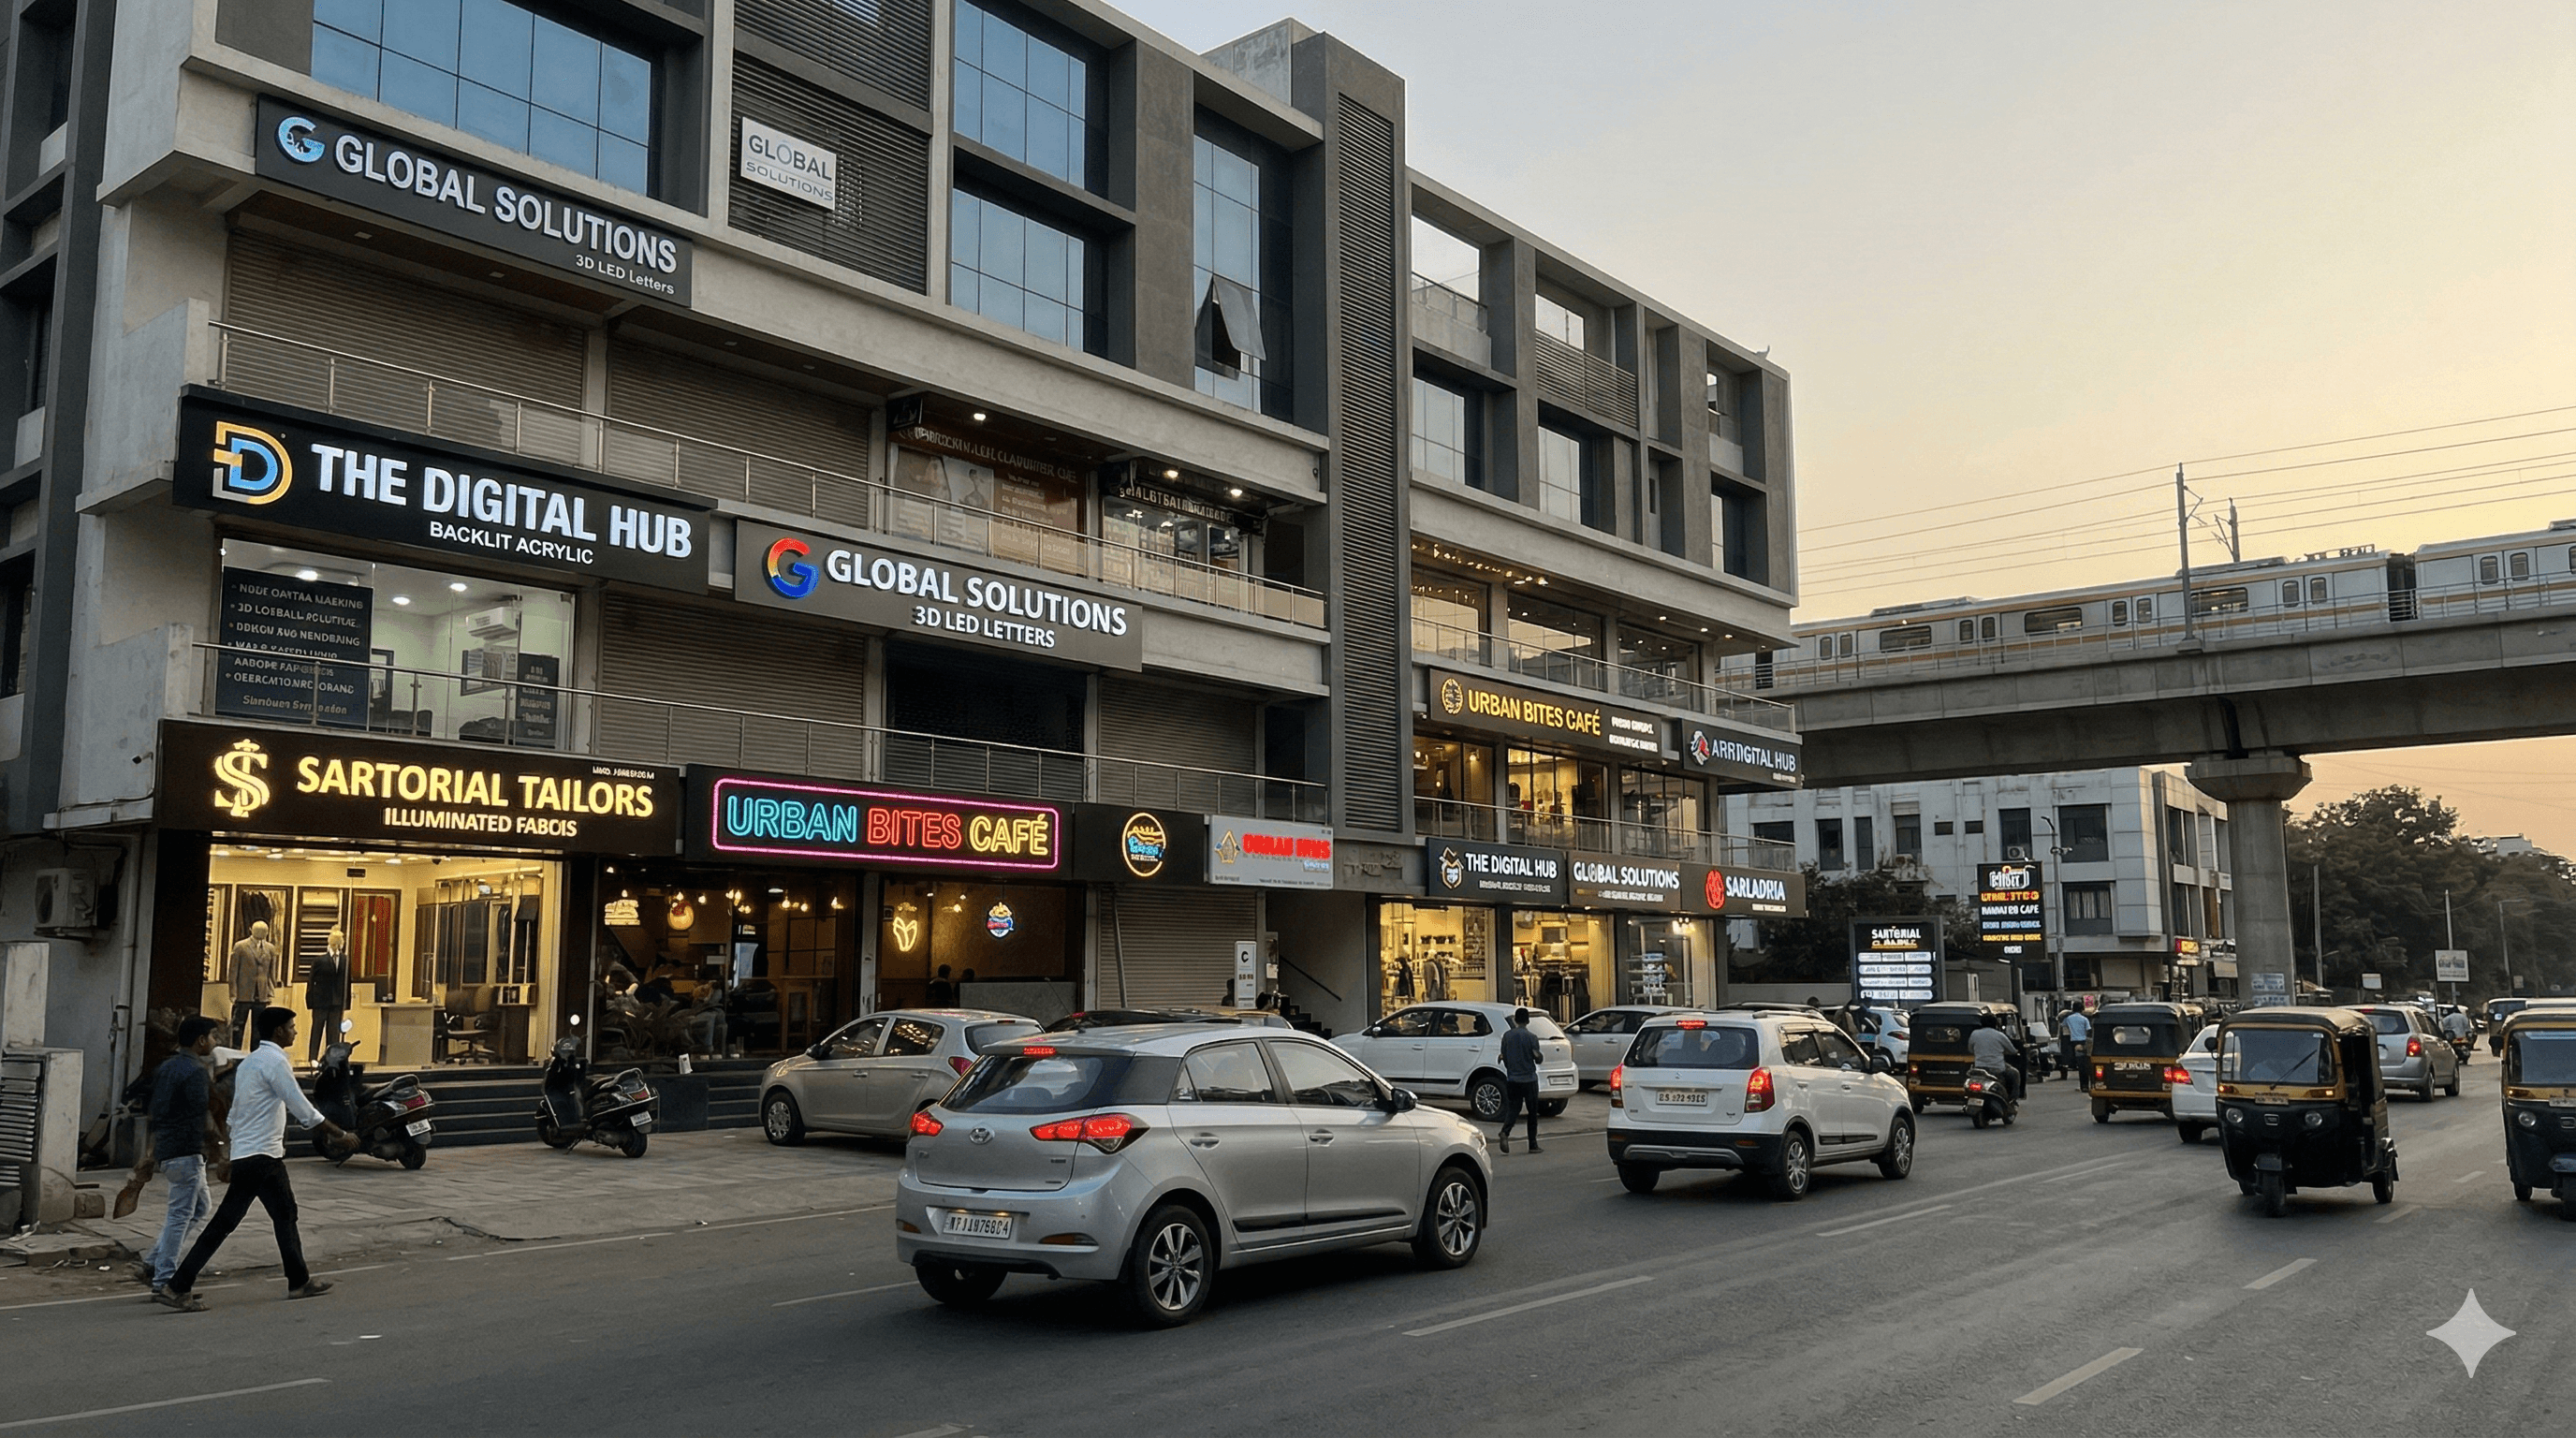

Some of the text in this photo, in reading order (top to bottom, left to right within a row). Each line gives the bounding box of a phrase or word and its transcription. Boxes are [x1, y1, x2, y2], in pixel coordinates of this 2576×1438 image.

[748, 133, 834, 183] GLOBAL
[334, 132, 678, 273] GLOBAL SOLUTIONS
[745, 162, 835, 202] SOLUTIONS
[575, 254, 676, 296] 3D LED Letters
[311, 443, 693, 559] THE DIGITAL HUB
[430, 520, 594, 565] BACKLIT ACRYLIC
[827, 549, 1128, 637] GLOBAL SOLUTIONS
[914, 605, 1056, 649] 3D LED LETTERS
[1468, 689, 1521, 721] URBAN
[1523, 699, 1564, 728] BITES
[1565, 708, 1602, 737] CAFÉ
[1775, 751, 1796, 772] HUB
[296, 756, 654, 817] SARTORIAL TAILORS
[384, 807, 512, 832] ILLUMINATED
[725, 795, 1048, 856] URBAN BITES CAFÉ
[1465, 852, 1558, 879] THE DIGITAL HUB
[1573, 861, 1680, 889] GLOBAL SOLUTIONS
